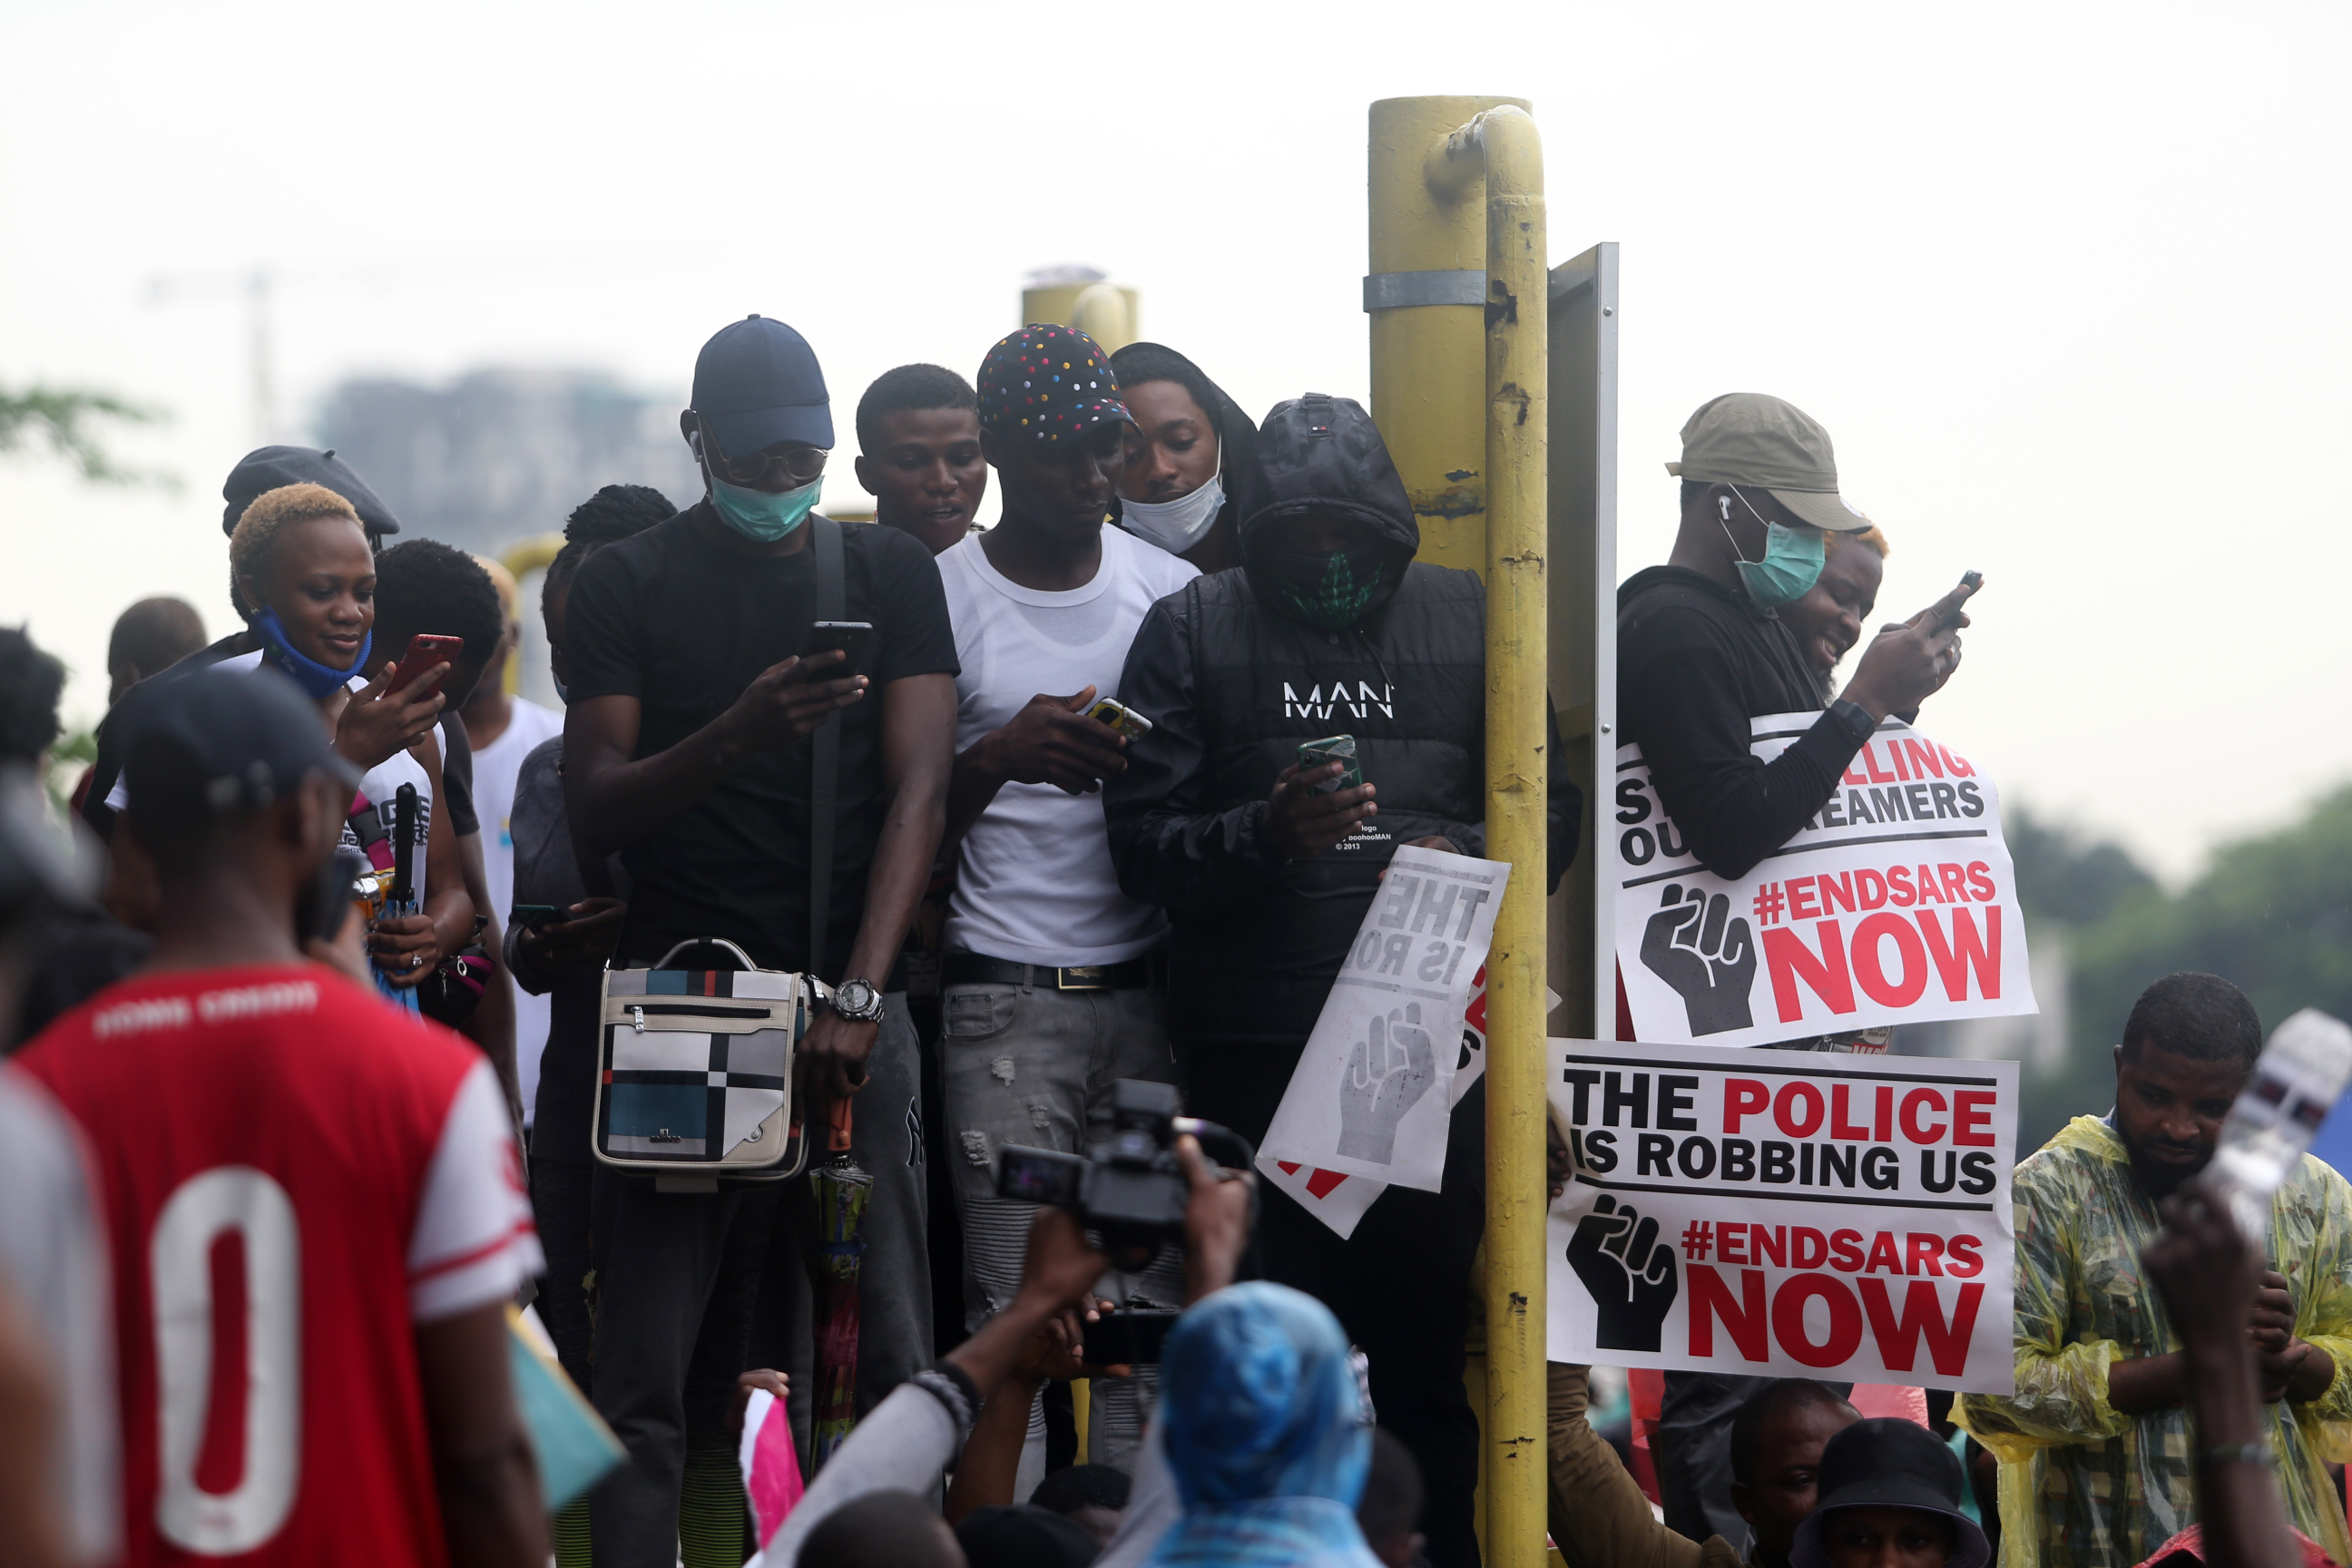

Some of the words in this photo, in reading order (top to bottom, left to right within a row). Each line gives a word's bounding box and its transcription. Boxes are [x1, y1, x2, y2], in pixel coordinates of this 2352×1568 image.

[1283, 681, 1394, 720] MAN
[1837, 738, 1976, 786] LLING
[1361, 825, 1377, 833] logo
[1804, 780, 1984, 831] EAMERS
[1619, 821, 1690, 866] OU
[1753, 860, 1996, 926] #ENDSARS
[1760, 905, 2002, 1024] NOW
[1563, 1068, 1699, 1132] THE
[1723, 1077, 1996, 1147] POLICE
[1570, 1128, 1618, 1174] IS
[1637, 1132, 1899, 1191] ROBBING
[1920, 1150, 1996, 1195] US
[1681, 1220, 1984, 1278] #ENDSARS
[1686, 1263, 1985, 1377] NOW
